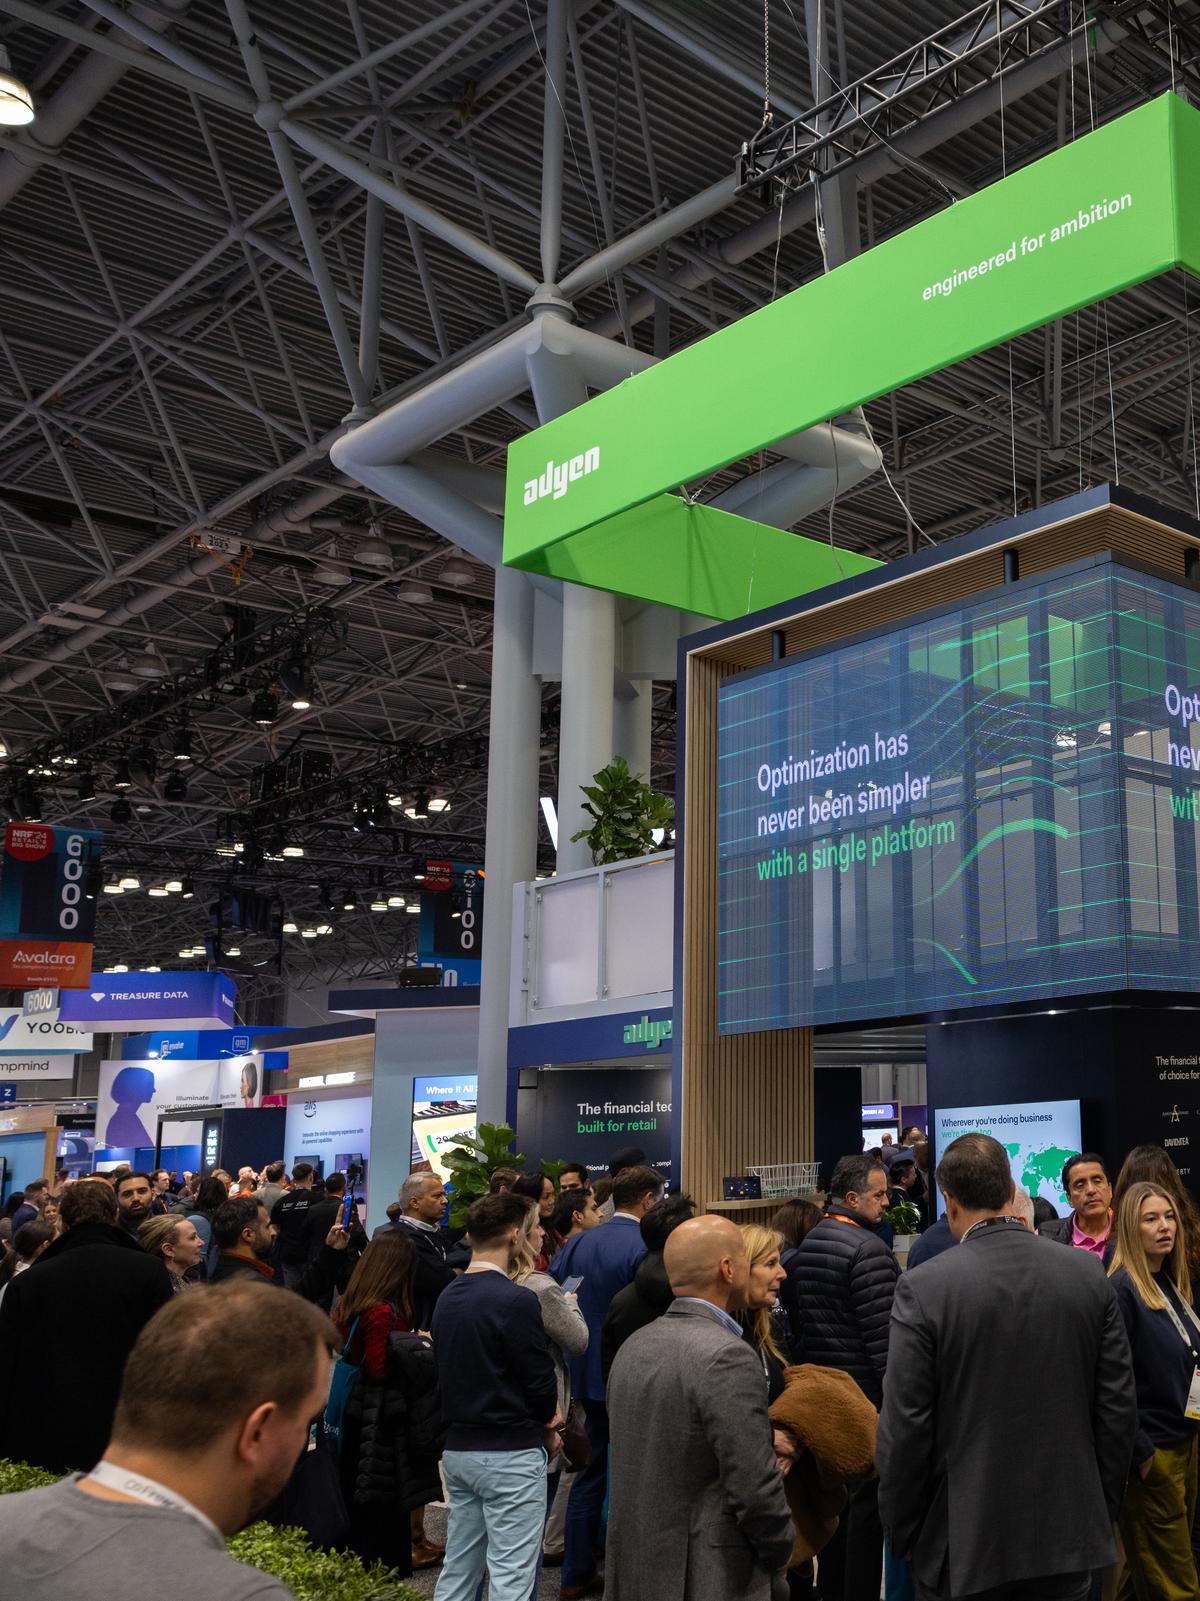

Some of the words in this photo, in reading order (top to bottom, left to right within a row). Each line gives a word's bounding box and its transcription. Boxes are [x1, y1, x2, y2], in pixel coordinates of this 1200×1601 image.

[922, 242, 1016, 300] engineered
[1020, 233, 1046, 256] for
[1050, 194, 1132, 243] ambition
[524, 446, 600, 506] adyen
[757, 741, 870, 797] Optimization
[875, 732, 908, 762] has
[757, 806, 805, 837] never
[809, 794, 853, 825] been
[858, 771, 931, 814] simpler
[12, 830, 33, 838] NRF
[757, 847, 793, 881] with
[797, 853, 807, 873] a
[812, 832, 866, 873] single
[871, 818, 955, 866] platform
[12, 950, 76, 964] Avalara
[28, 991, 52, 1013] 6000
[110, 992, 161, 1001] TREASURE
[163, 991, 189, 999] DATA
[1156, 1056, 1169, 1066] The
[1170, 1056, 1198, 1066] financial
[1159, 1071, 1167, 1080] of
[1167, 1070, 1190, 1080] choice
[1190, 1070, 1200, 1079] for
[463, 1085, 474, 1093] All
[577, 1103, 600, 1115] The
[604, 1101, 653, 1114] financial
[577, 1121, 604, 1133] built
[607, 1121, 623, 1132] for
[627, 1118, 657, 1131] retail
[941, 1117, 975, 1128] Wherever
[975, 1117, 997, 1128] you're
[998, 1115, 1019, 1126] doing
[1019, 1113, 1053, 1123] business
